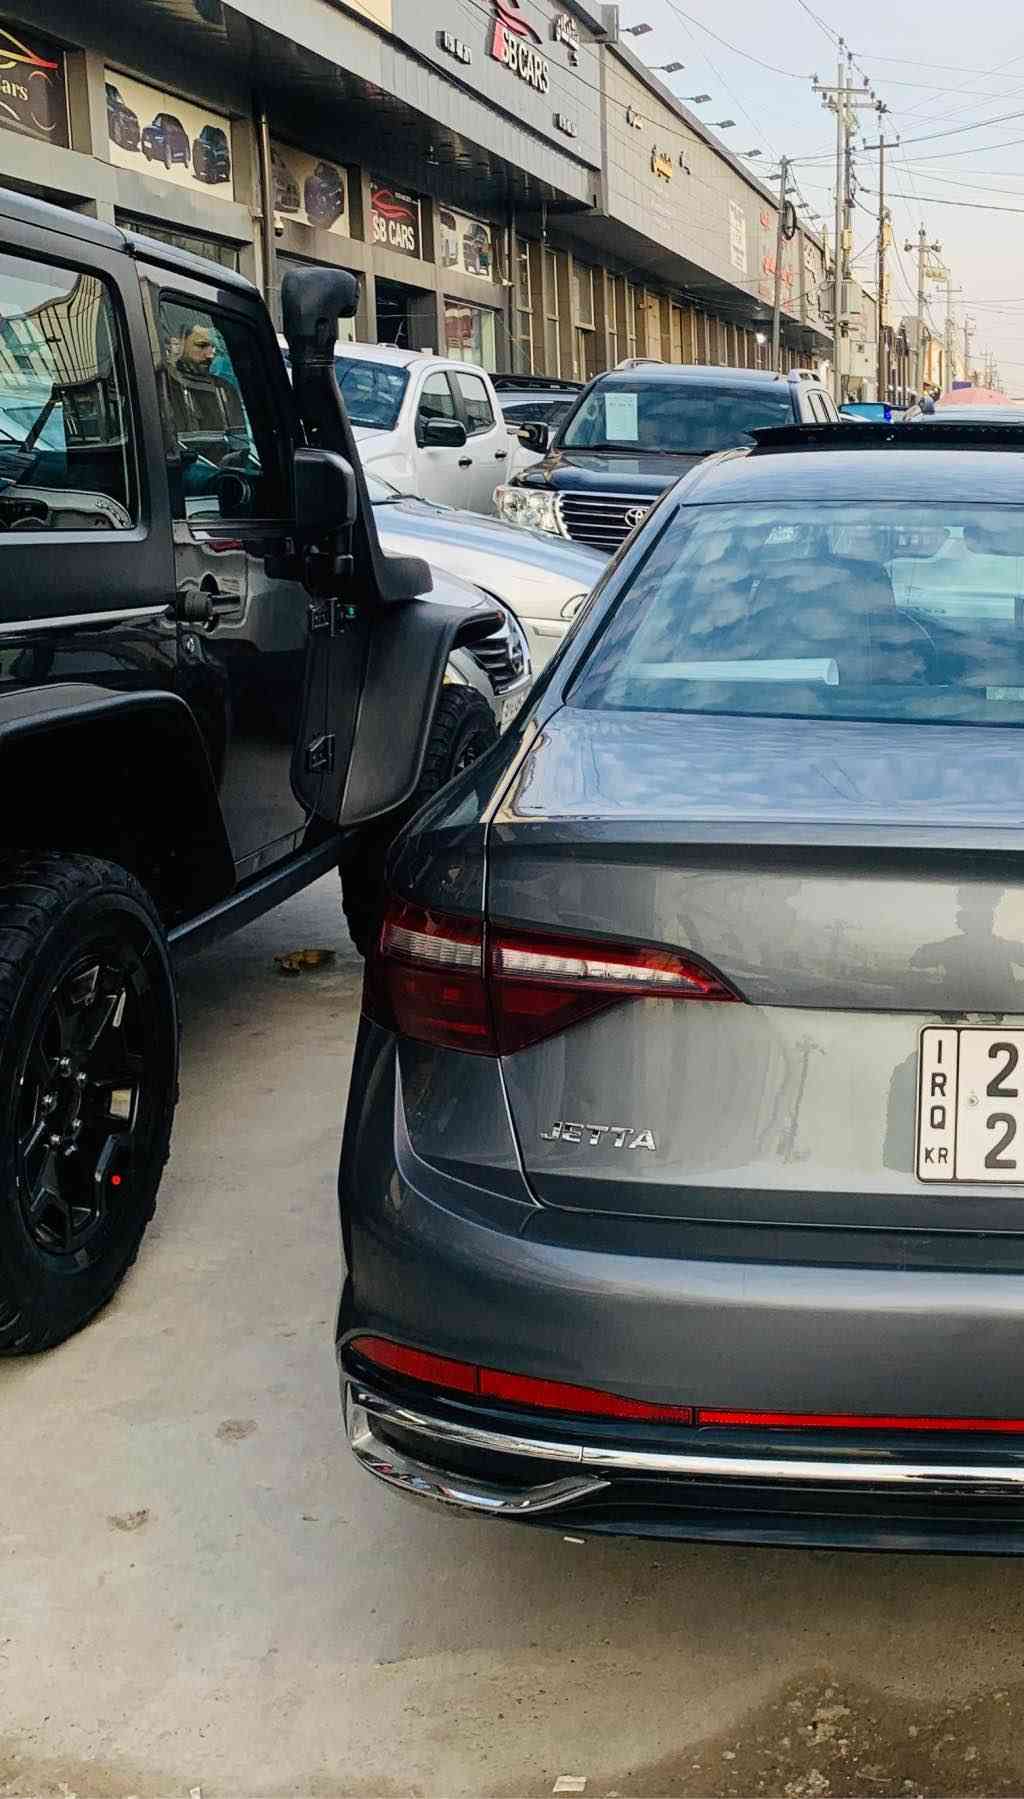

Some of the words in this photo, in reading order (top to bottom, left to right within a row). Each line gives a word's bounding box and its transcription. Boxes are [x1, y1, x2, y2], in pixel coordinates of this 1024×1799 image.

[503, 28, 518, 70] SB
[518, 42, 549, 93] CARS
[0, 79, 28, 101] ars
[373, 215, 387, 242] SB
[388, 220, 415, 250] CARS
[540, 1121, 656, 1151] JETTA
[924, 1147, 948, 1164] KR
